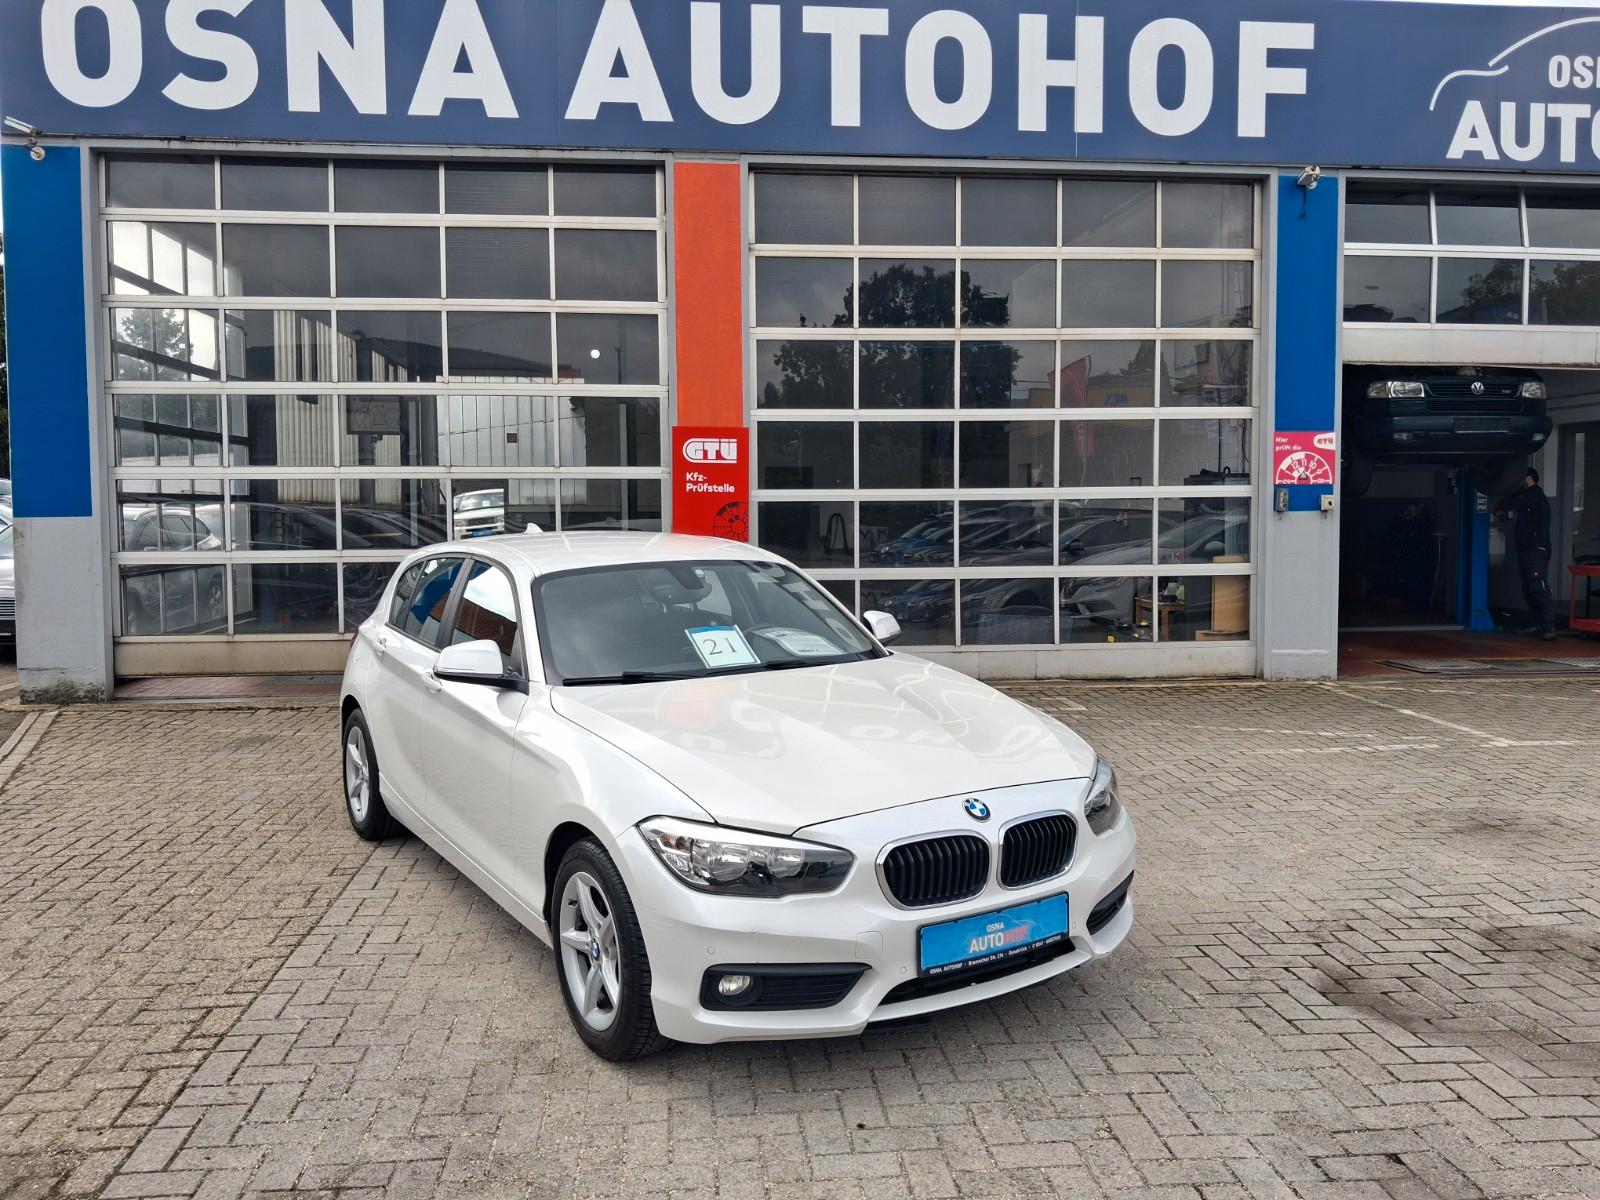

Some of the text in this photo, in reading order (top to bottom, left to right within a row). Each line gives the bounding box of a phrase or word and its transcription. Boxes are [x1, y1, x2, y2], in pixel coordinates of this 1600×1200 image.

[41, 0, 1314, 137] OSNA AUTOHOF
[684, 439, 737, 461] GTÜ
[686, 472, 708, 481] Kfz-
[686, 483, 735, 493] Prüfstelle
[702, 637, 737, 655] 21
